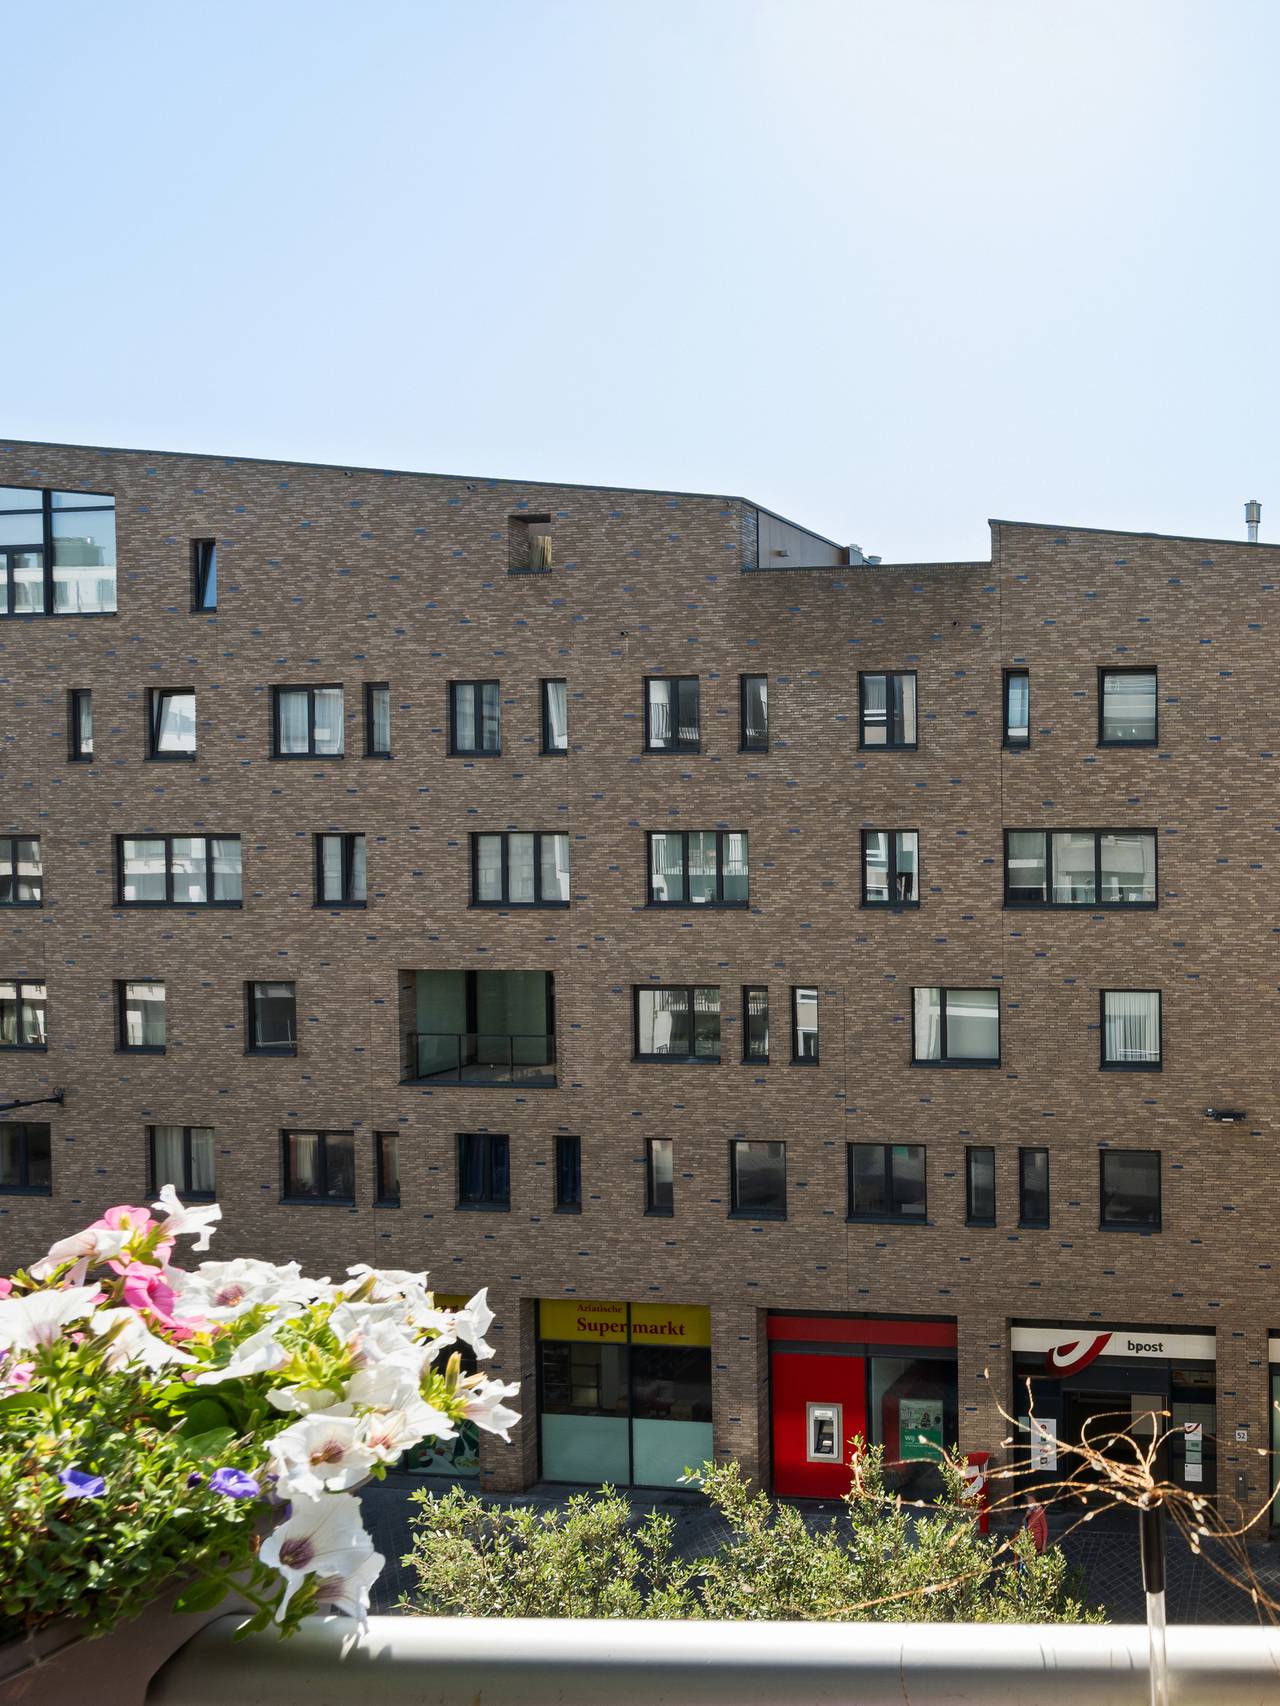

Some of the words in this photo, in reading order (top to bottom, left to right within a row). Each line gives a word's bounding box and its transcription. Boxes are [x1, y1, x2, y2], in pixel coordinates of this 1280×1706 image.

[576, 1303, 623, 1313] Aziatische
[576, 1317, 686, 1336] Supermarkt
[1127, 1340, 1164, 1354] bpost
[1236, 1432, 1246, 1440] 52
